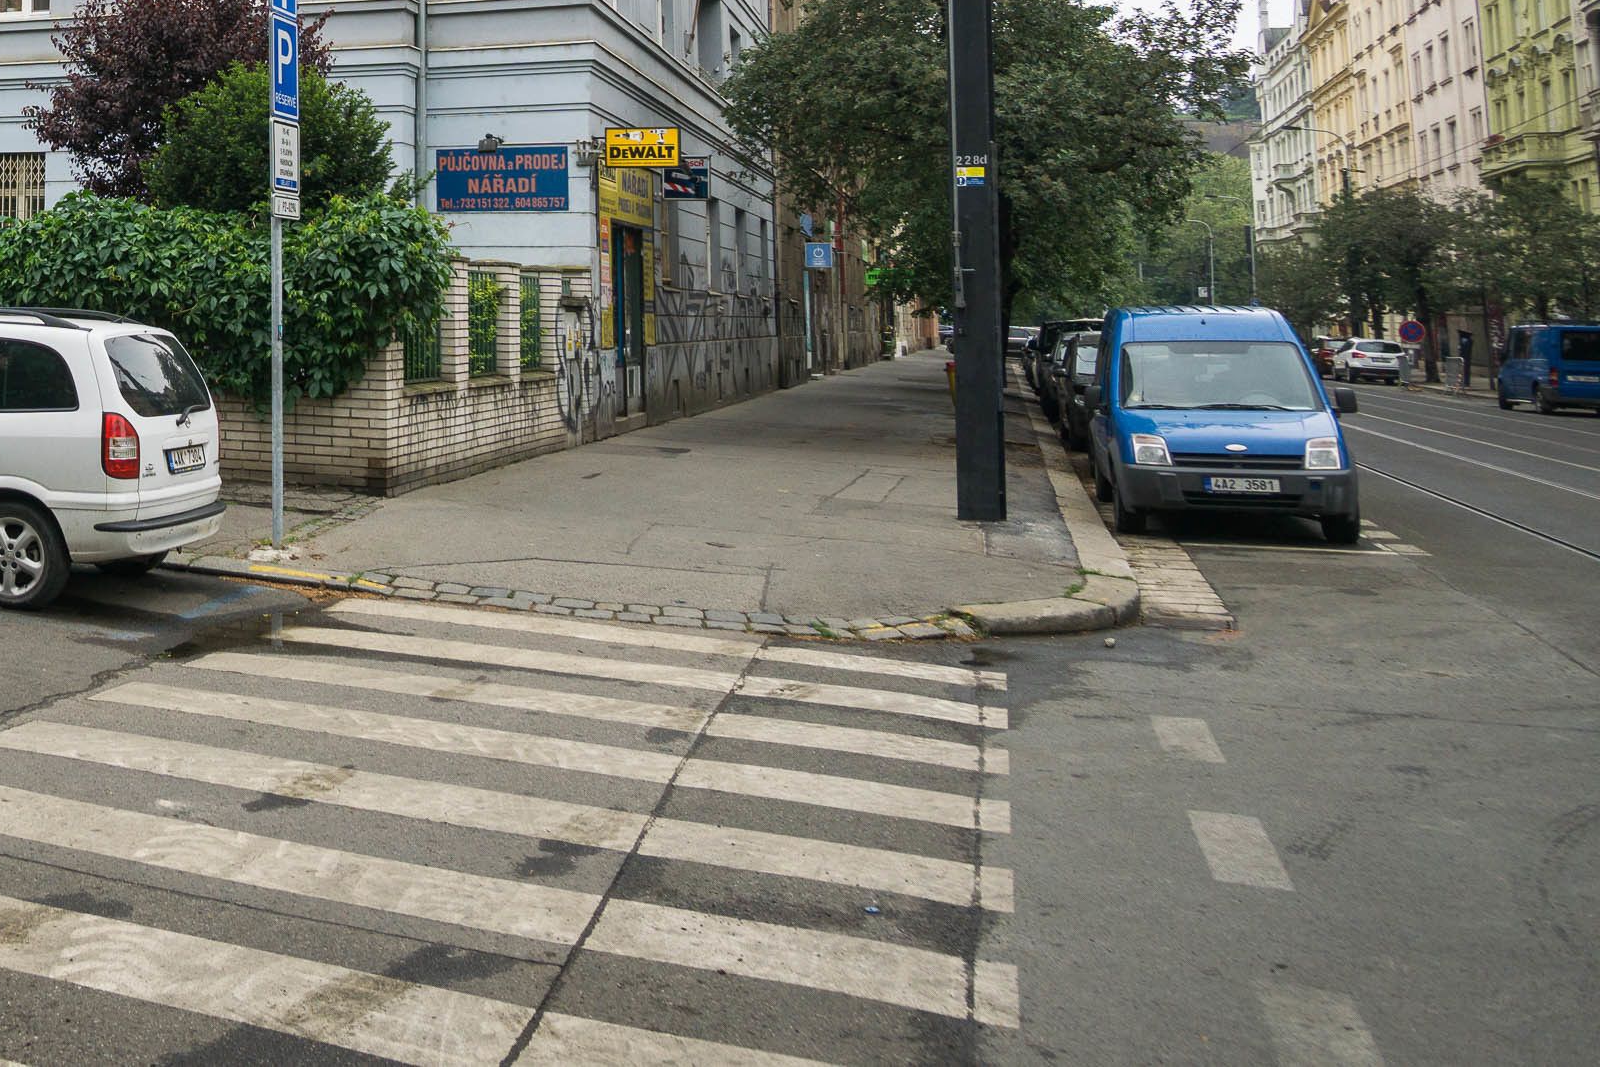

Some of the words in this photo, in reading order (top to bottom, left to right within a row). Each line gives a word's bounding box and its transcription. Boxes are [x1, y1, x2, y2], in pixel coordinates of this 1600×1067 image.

[277, 28, 293, 85] P
[275, 91, 296, 109] RÉSERVÉ
[439, 152, 505, 172] PŮJČOVNA
[507, 161, 513, 171] a
[515, 153, 566, 170] PRODEJ
[467, 174, 537, 194] NÁŘADÍ
[460, 198, 475, 208] 732
[1214, 478, 1236, 490] 4A2
[1244, 479, 1274, 491] 3581
